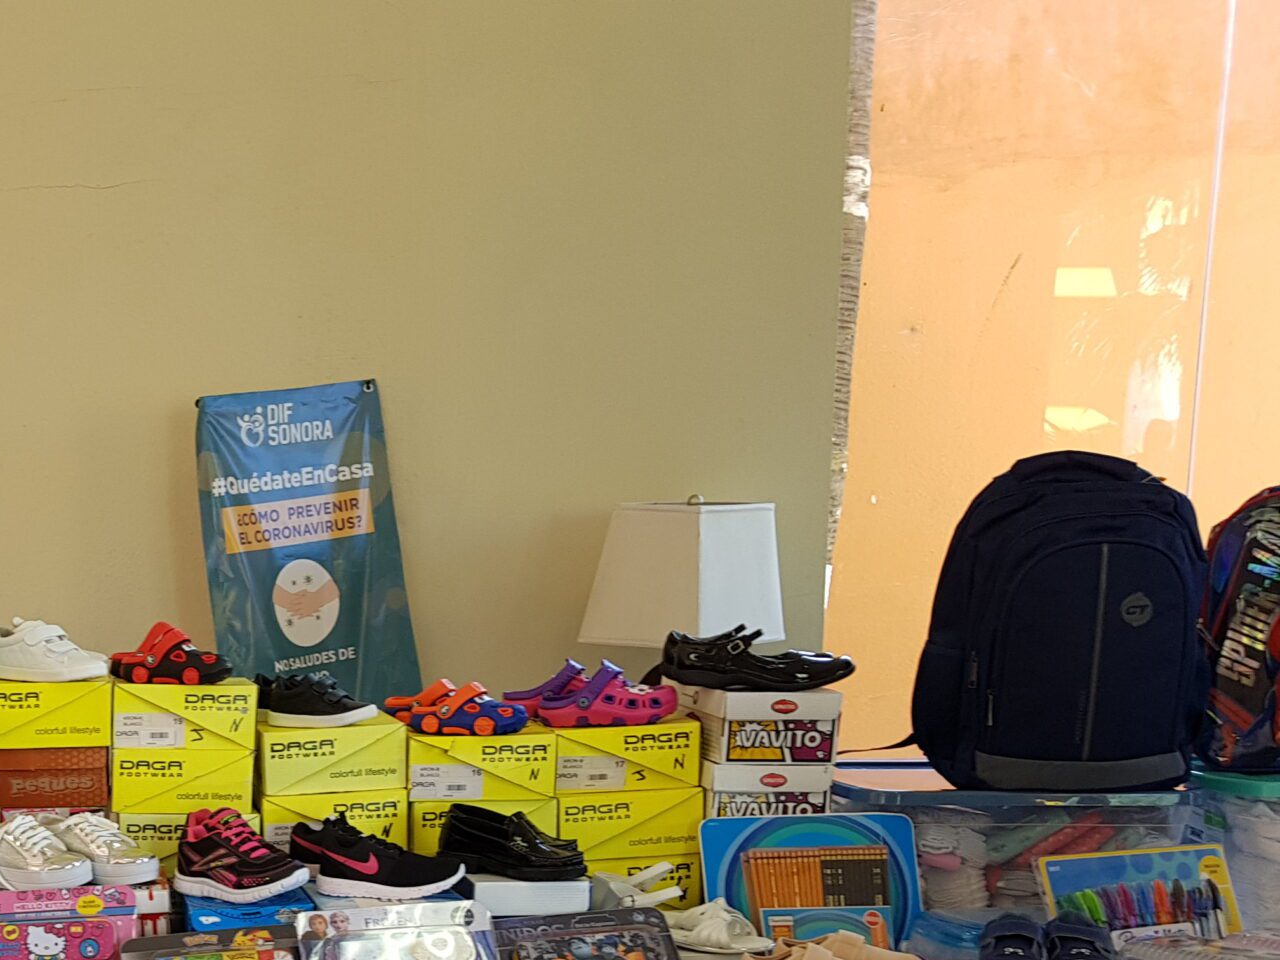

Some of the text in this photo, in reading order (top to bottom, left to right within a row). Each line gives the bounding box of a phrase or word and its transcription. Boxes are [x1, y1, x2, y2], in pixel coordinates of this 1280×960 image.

[267, 403, 294, 425] DIF
[268, 420, 334, 446] SONORA
[211, 461, 374, 497] #QuédateEnCasa
[237, 498, 360, 528] ¿CÓMO PREVENIR
[239, 515, 363, 546] EL CORONAVIRUS?
[274, 646, 358, 673] NO SALUDES DE
[184, 694, 248, 704] DAGA
[34, 725, 101, 736] colorfull lifestyle
[624, 732, 690, 745] DAGA
[270, 739, 335, 753] DAGA
[481, 745, 548, 755] DAGA
[624, 744, 690, 752] FOOTWEAR
[270, 751, 335, 759] FOOTWEAR
[120, 761, 183, 771] DAGA
[329, 766, 397, 779] colorfull lifestyle
[9, 773, 97, 798] peques
[176, 792, 243, 802] colorfull lifestyle
[333, 801, 398, 813] DAGA
[564, 803, 630, 815] DAGA
[564, 814, 631, 823] FOOTWEAR
[629, 834, 698, 846] colorfull lifestyle
